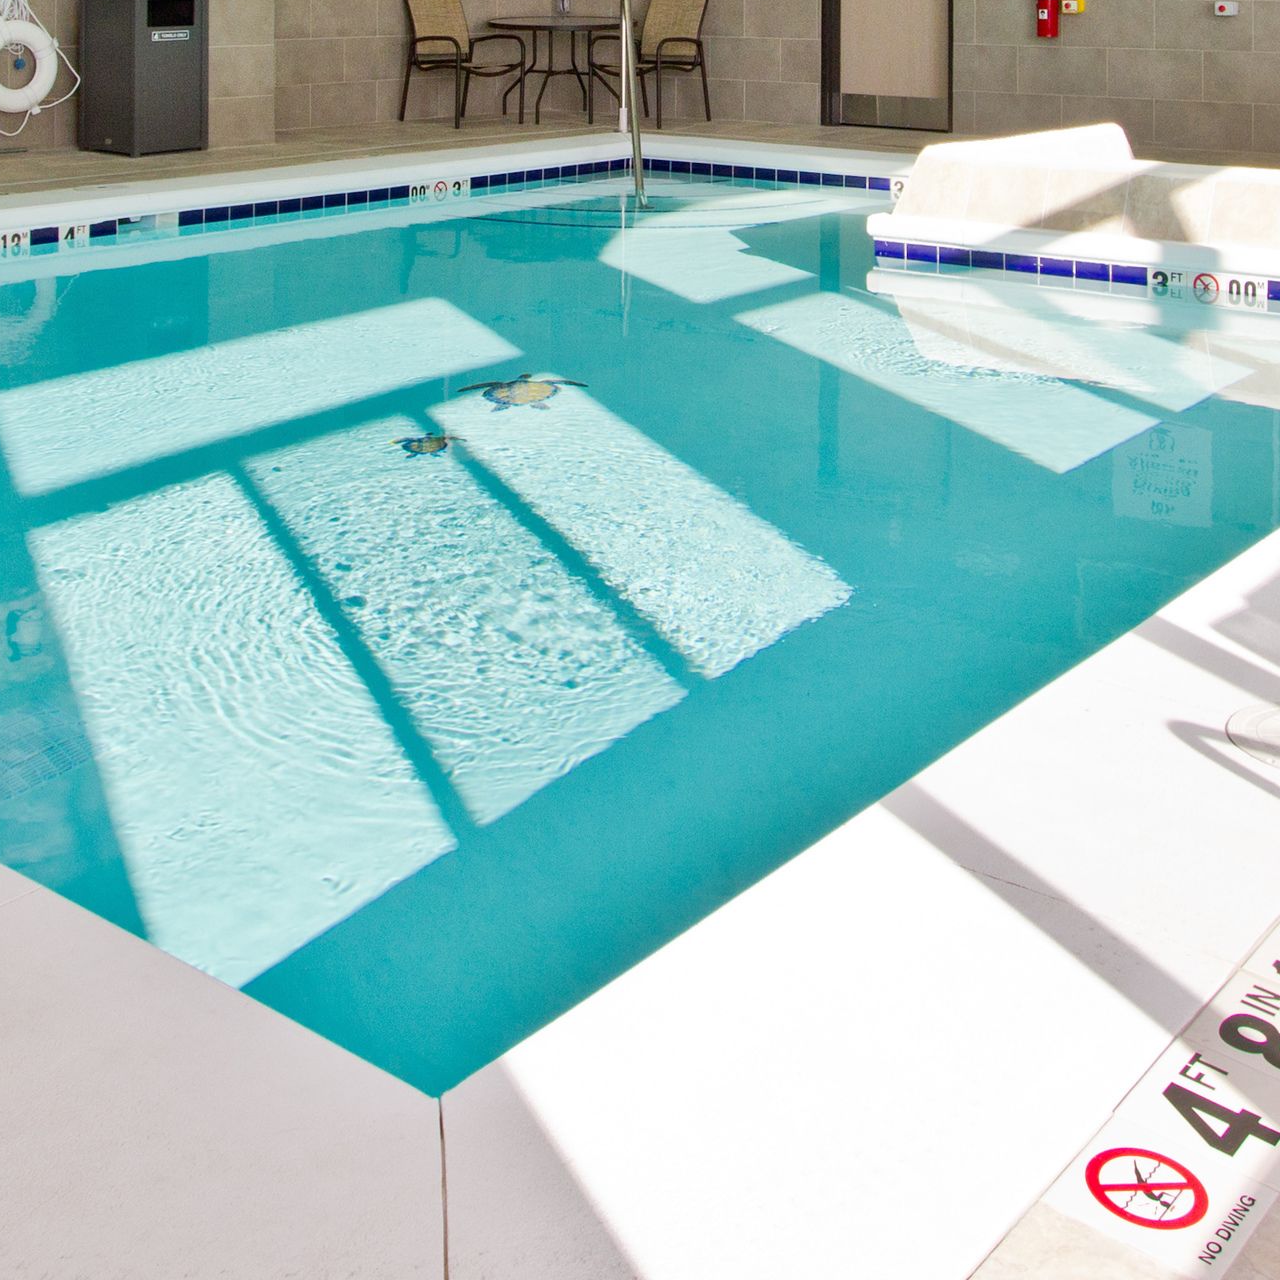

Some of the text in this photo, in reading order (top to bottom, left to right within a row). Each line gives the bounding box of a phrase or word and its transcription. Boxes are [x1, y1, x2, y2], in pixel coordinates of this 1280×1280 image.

[1171, 272, 1183, 284] FT
[1178, 1053, 1230, 1091] FT
[1198, 1194, 1257, 1265] NO DIVING
